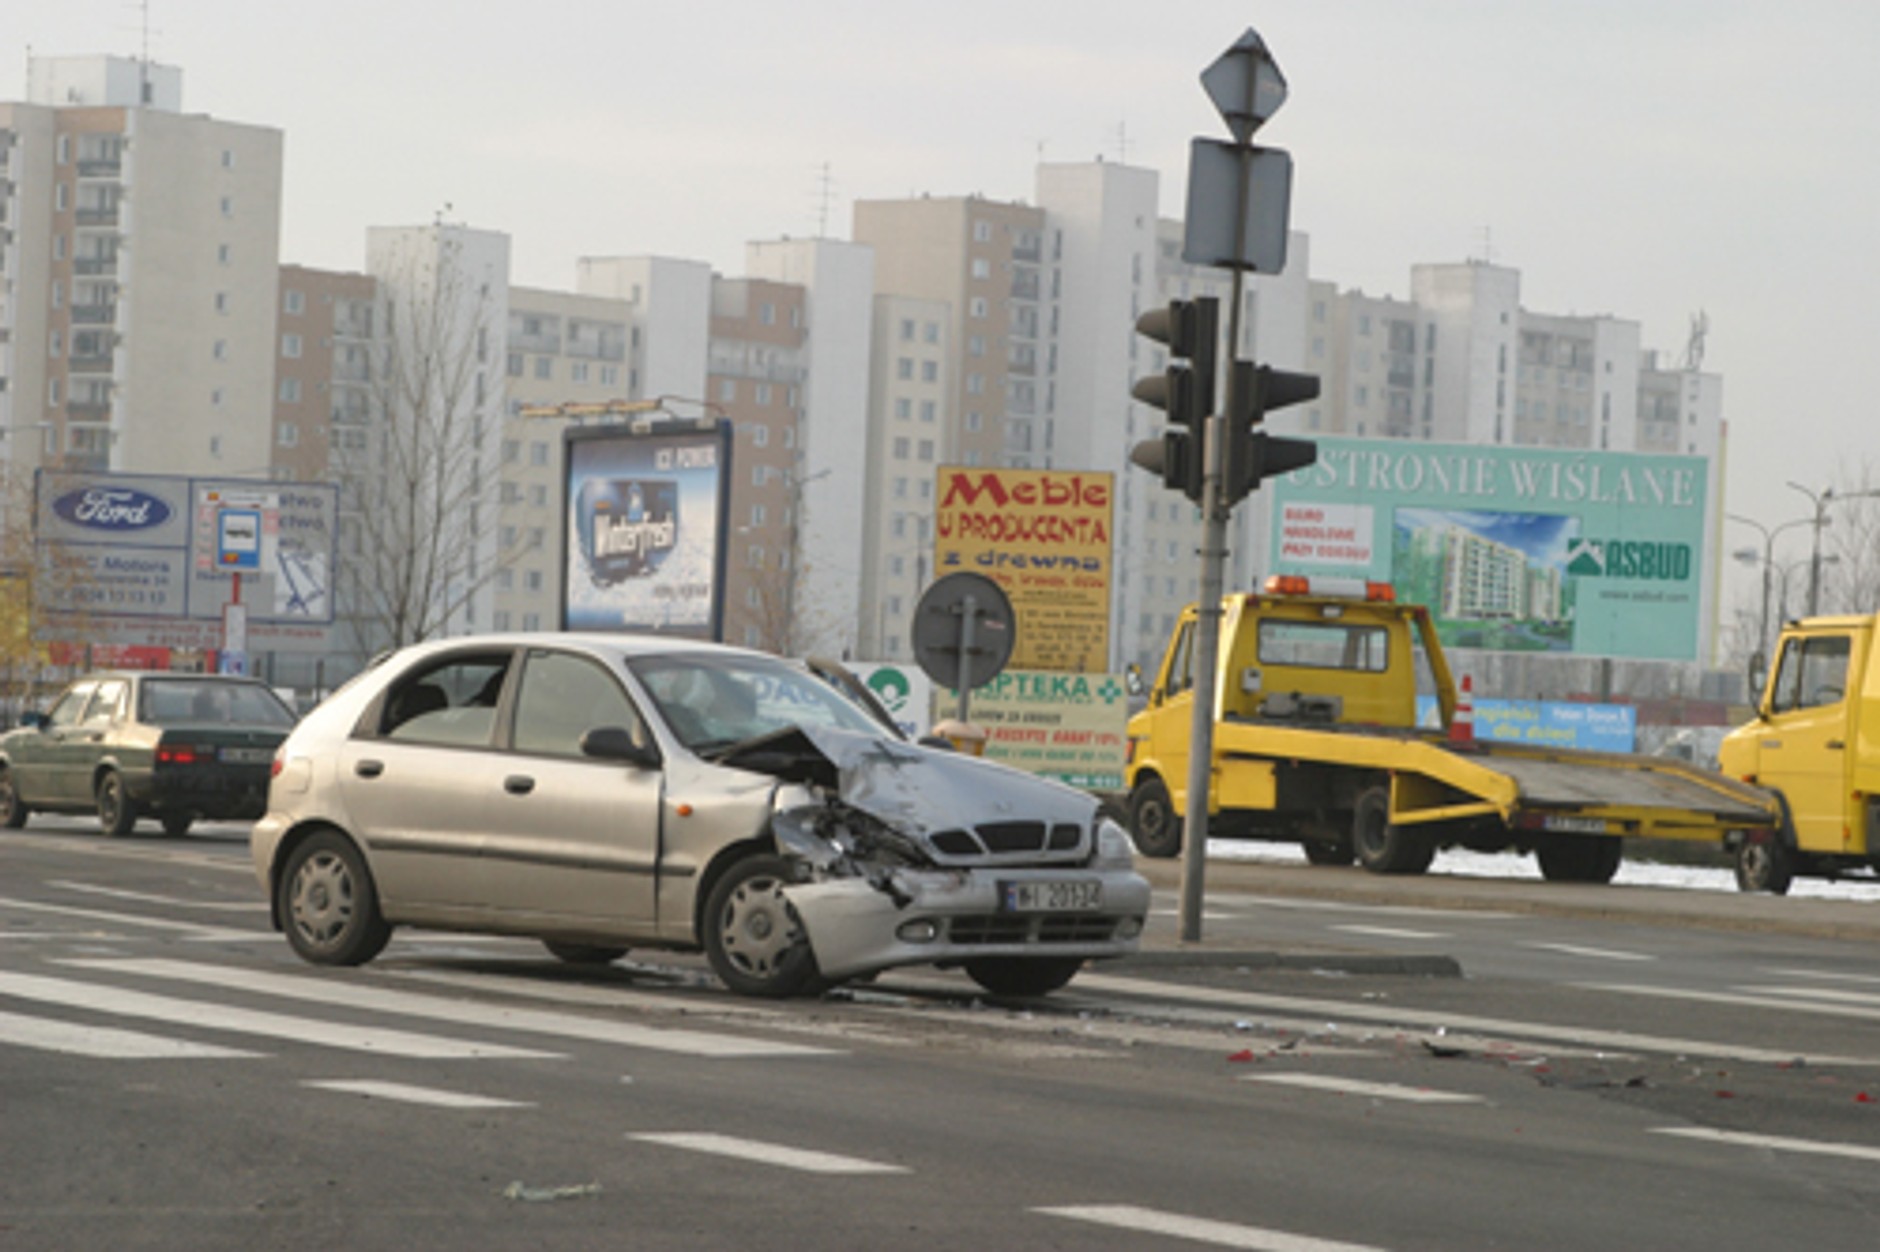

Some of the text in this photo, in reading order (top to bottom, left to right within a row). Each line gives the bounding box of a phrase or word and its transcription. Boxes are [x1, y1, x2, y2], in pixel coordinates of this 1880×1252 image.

[941, 472, 1108, 509] Meble
[1509, 456, 1695, 508] WIŚLANE
[74, 490, 151, 525] Ford
[594, 509, 675, 560] Winterfresh
[939, 512, 1107, 544] U PRODUCENTA
[975, 550, 1100, 571] drewna
[1605, 540, 1690, 580] ASBUD
[1474, 703, 1538, 723] ngielski
